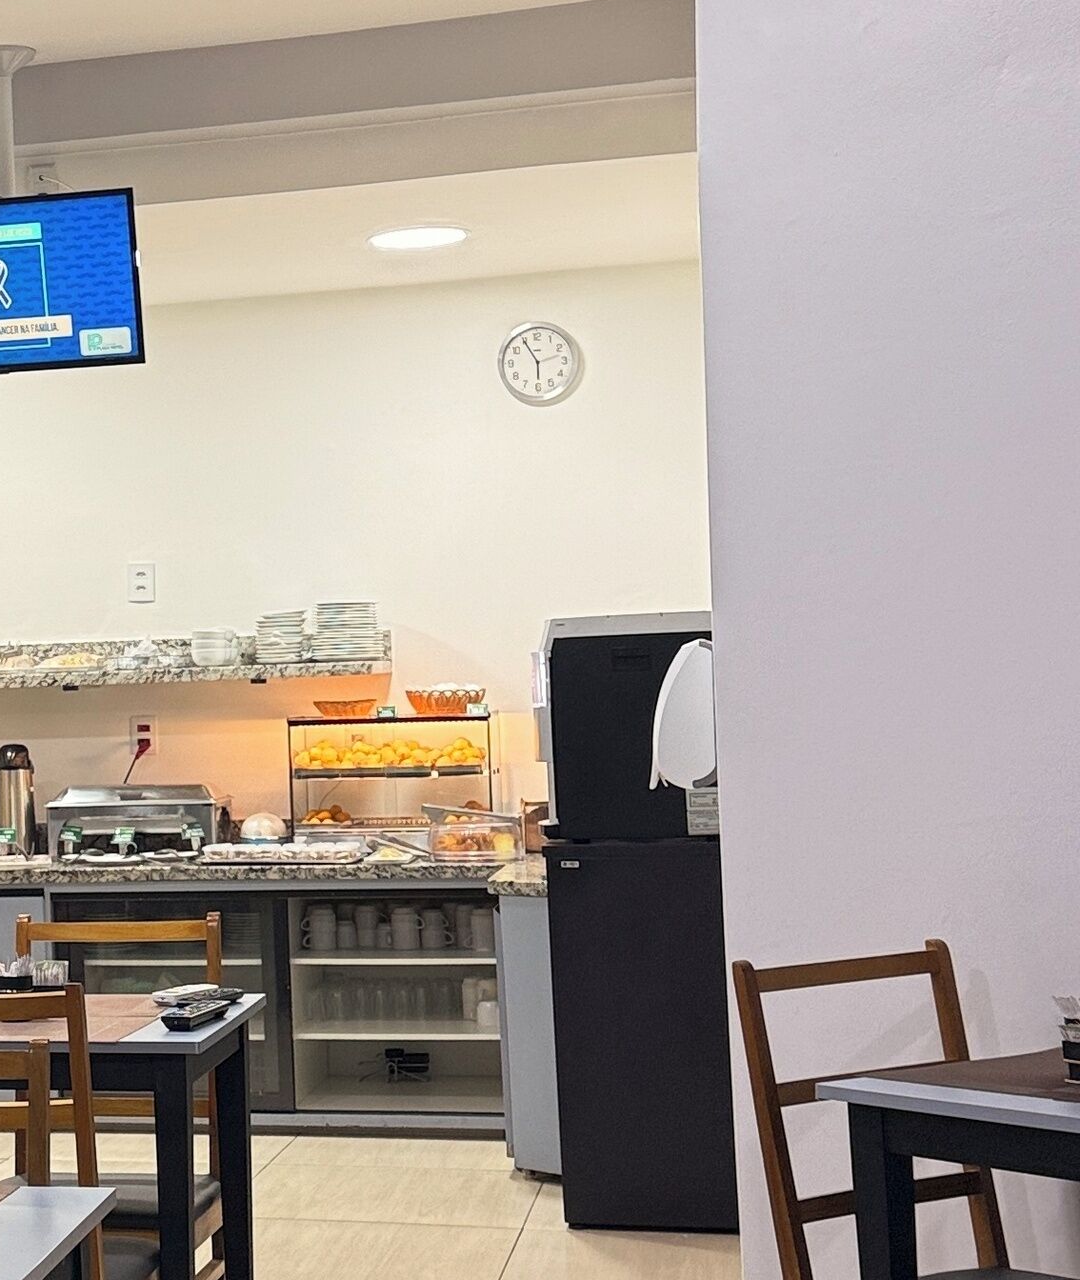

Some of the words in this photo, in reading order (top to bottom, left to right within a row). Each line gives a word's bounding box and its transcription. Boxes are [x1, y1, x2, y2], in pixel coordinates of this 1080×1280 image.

[20, 324, 30, 334] NA
[532, 332, 541, 341] 12
[512, 346, 520, 355] 10
[556, 344, 563, 352] 2
[508, 359, 514, 368] 9
[561, 356, 568, 365] 3
[512, 371, 519, 380] 8
[523, 380, 528, 388] 7
[535, 383, 541, 391] 6
[548, 378, 554, 387] 5
